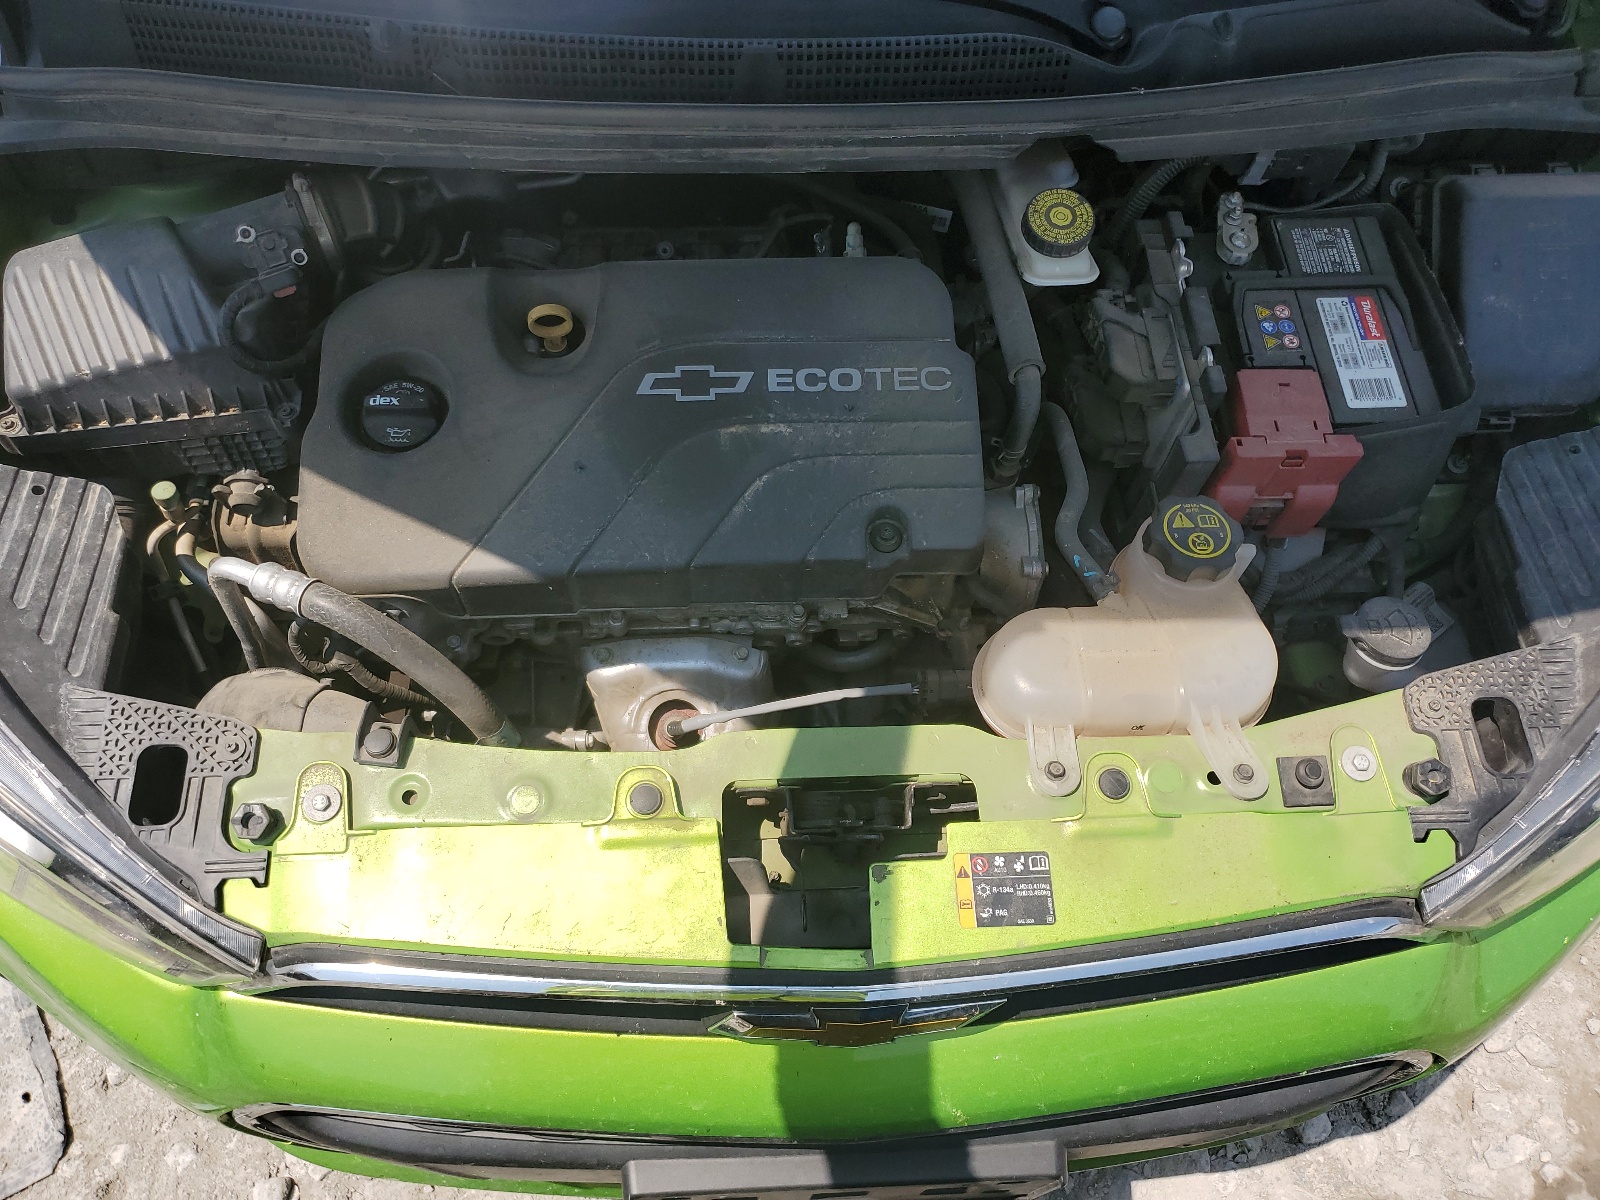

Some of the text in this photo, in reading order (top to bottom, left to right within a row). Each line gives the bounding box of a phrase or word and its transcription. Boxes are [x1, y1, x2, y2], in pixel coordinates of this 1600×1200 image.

[1361, 299, 1381, 338] Duralast
[767, 366, 952, 392] ECOTEC
[383, 382, 425, 393] SAE 5W-20
[369, 395, 400, 406] dex
[995, 909, 1009, 917] PAG
